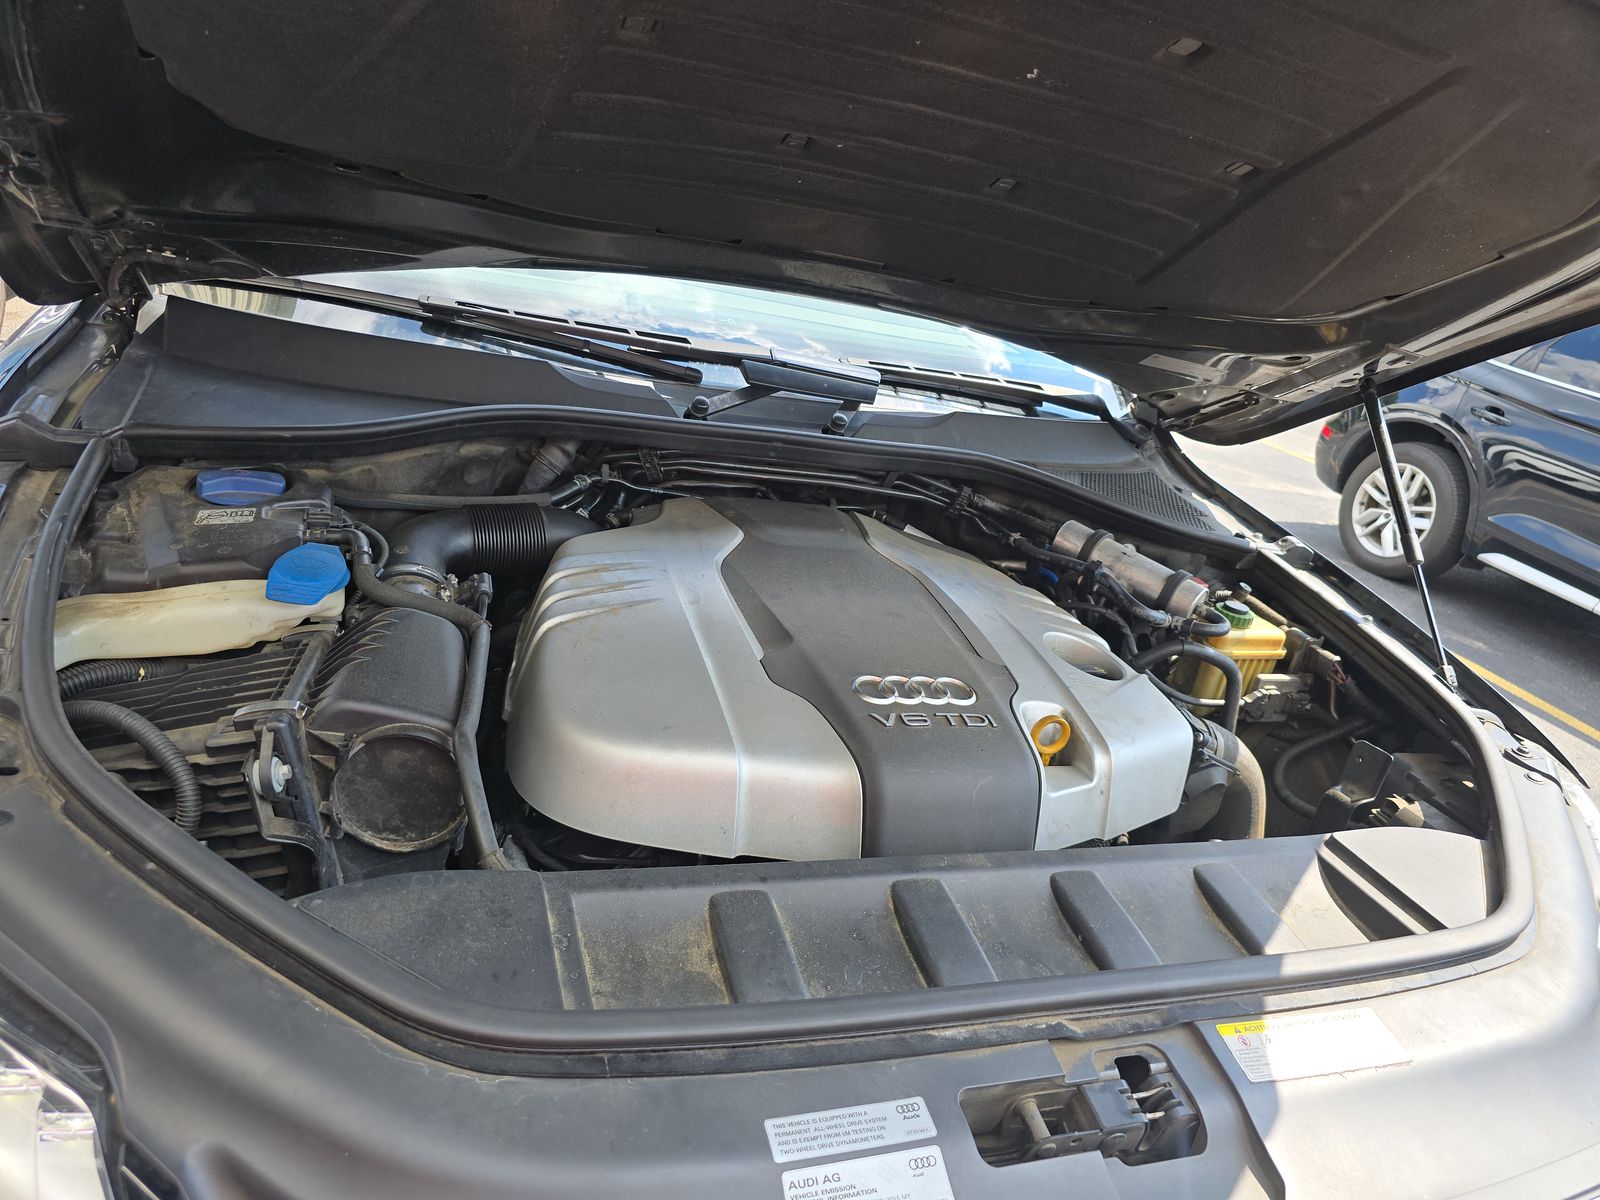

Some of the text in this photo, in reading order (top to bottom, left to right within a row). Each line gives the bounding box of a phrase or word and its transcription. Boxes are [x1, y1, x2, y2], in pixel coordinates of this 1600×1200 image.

[934, 713, 997, 728] TDI
[774, 1128, 811, 1138] PERMANENT
[813, 1122, 846, 1132] ALL-WHEEL
[864, 1116, 888, 1124] SYSTEM
[787, 1119, 811, 1128] VEHICLE
[819, 1113, 847, 1123] EQUIPPED
[778, 1139, 791, 1147] AND
[799, 1134, 823, 1143] EXEMPT
[823, 1131, 841, 1140] FROM
[852, 1126, 877, 1135] TESTING
[779, 1145, 816, 1155] TWO-WHEEL
[835, 1134, 886, 1147] DYNAMOMETERS
[788, 1172, 841, 1191] AUDI AG
[790, 1190, 820, 1200] VEHICLE
[821, 1183, 856, 1194] EMISSION
[827, 1187, 878, 1200] INFORMATION
